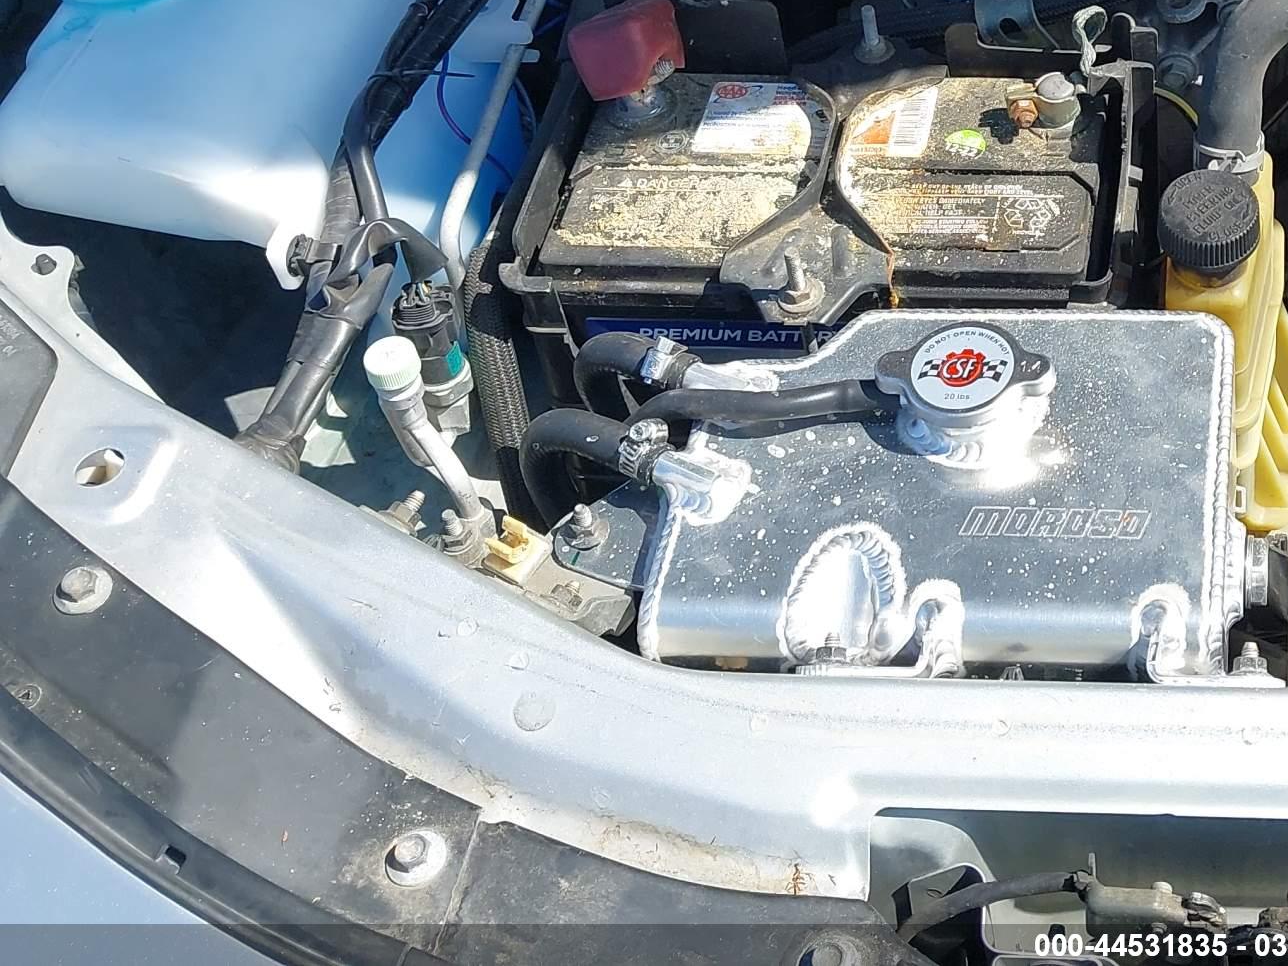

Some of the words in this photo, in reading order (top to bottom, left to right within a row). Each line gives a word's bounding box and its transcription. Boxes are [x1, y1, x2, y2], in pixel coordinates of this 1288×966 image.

[639, 328, 741, 342] PREMIUM
[953, 330, 977, 338] OPEN
[942, 357, 977, 379] CSF
[958, 506, 1152, 540] MOROSO
